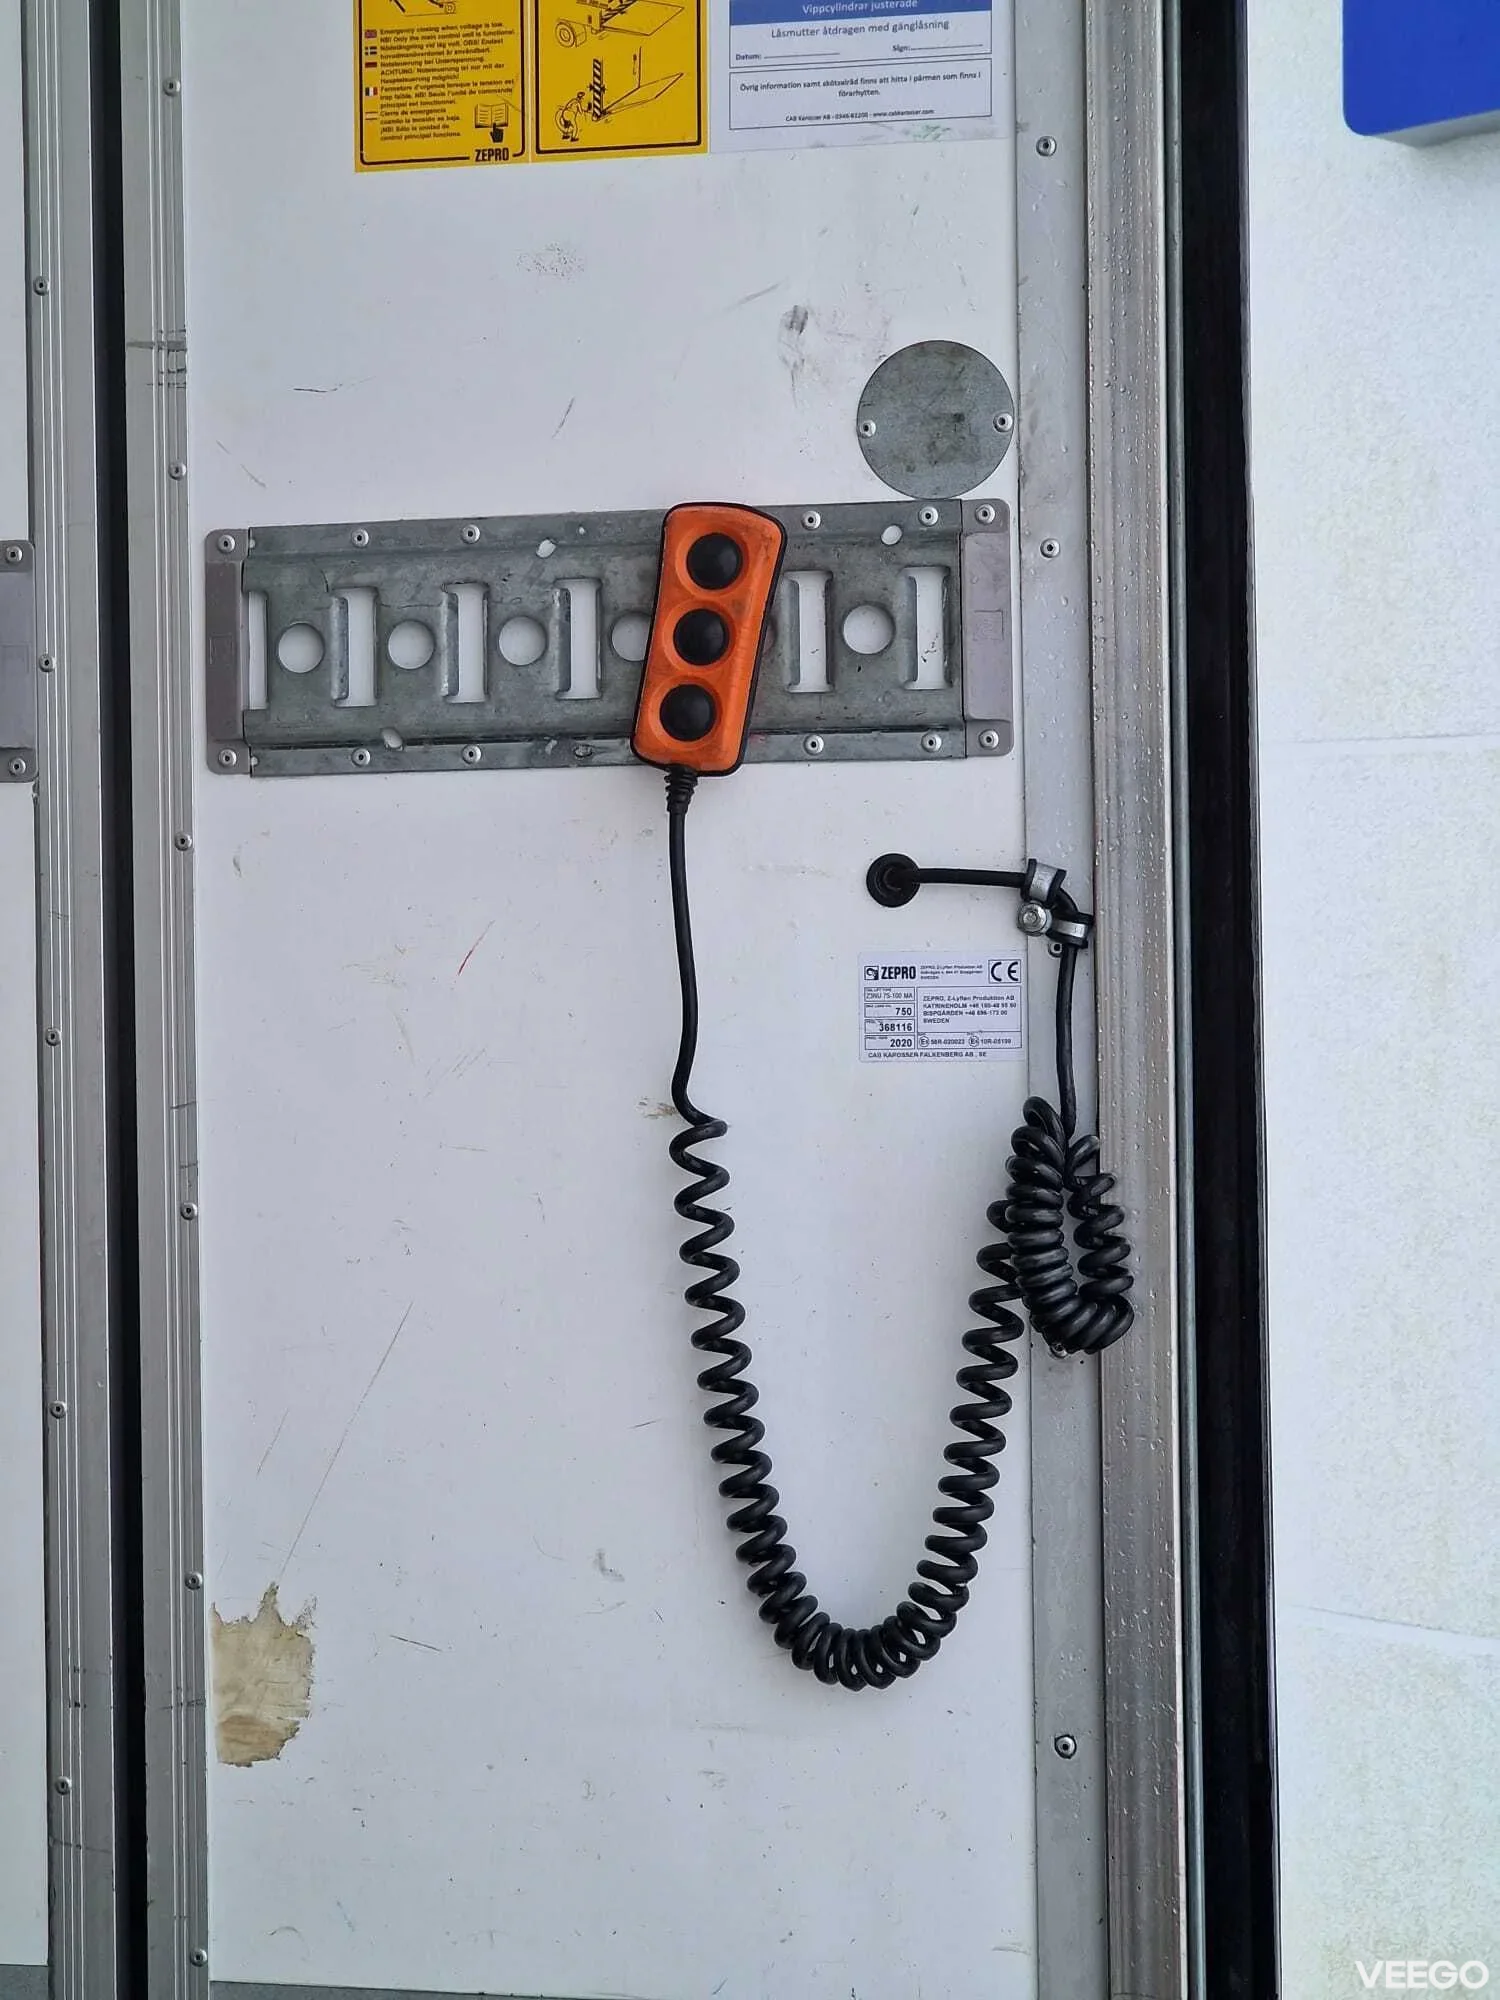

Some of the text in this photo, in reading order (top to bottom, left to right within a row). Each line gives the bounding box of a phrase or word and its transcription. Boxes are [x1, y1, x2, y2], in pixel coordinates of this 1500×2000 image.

[802, 0, 918, 16] Vippcylindrar justerade
[771, 20, 950, 38] Låsmutter åtdragen med gänglåsning
[736, 44, 911, 60] Datum: Sign:
[740, 82, 759, 92] Övrig
[760, 80, 802, 90] information
[803, 80, 820, 88] samt
[823, 78, 859, 88] skötselråd
[860, 77, 878, 85] finns
[879, 76, 890, 84] att
[890, 74, 908, 83] hitta
[914, 73, 941, 82] pärmen
[942, 72, 958, 80] som
[959, 71, 977, 80] finns
[838, 89, 880, 98] förarhytten.
[475, 148, 509, 162] ZEPRO
[880, 966, 916, 980] ZEPRO
[990, 961, 1018, 982] CE
[896, 1007, 912, 1016] 750
[880, 1023, 912, 1032] 368116
[890, 1038, 912, 1048] 2020
